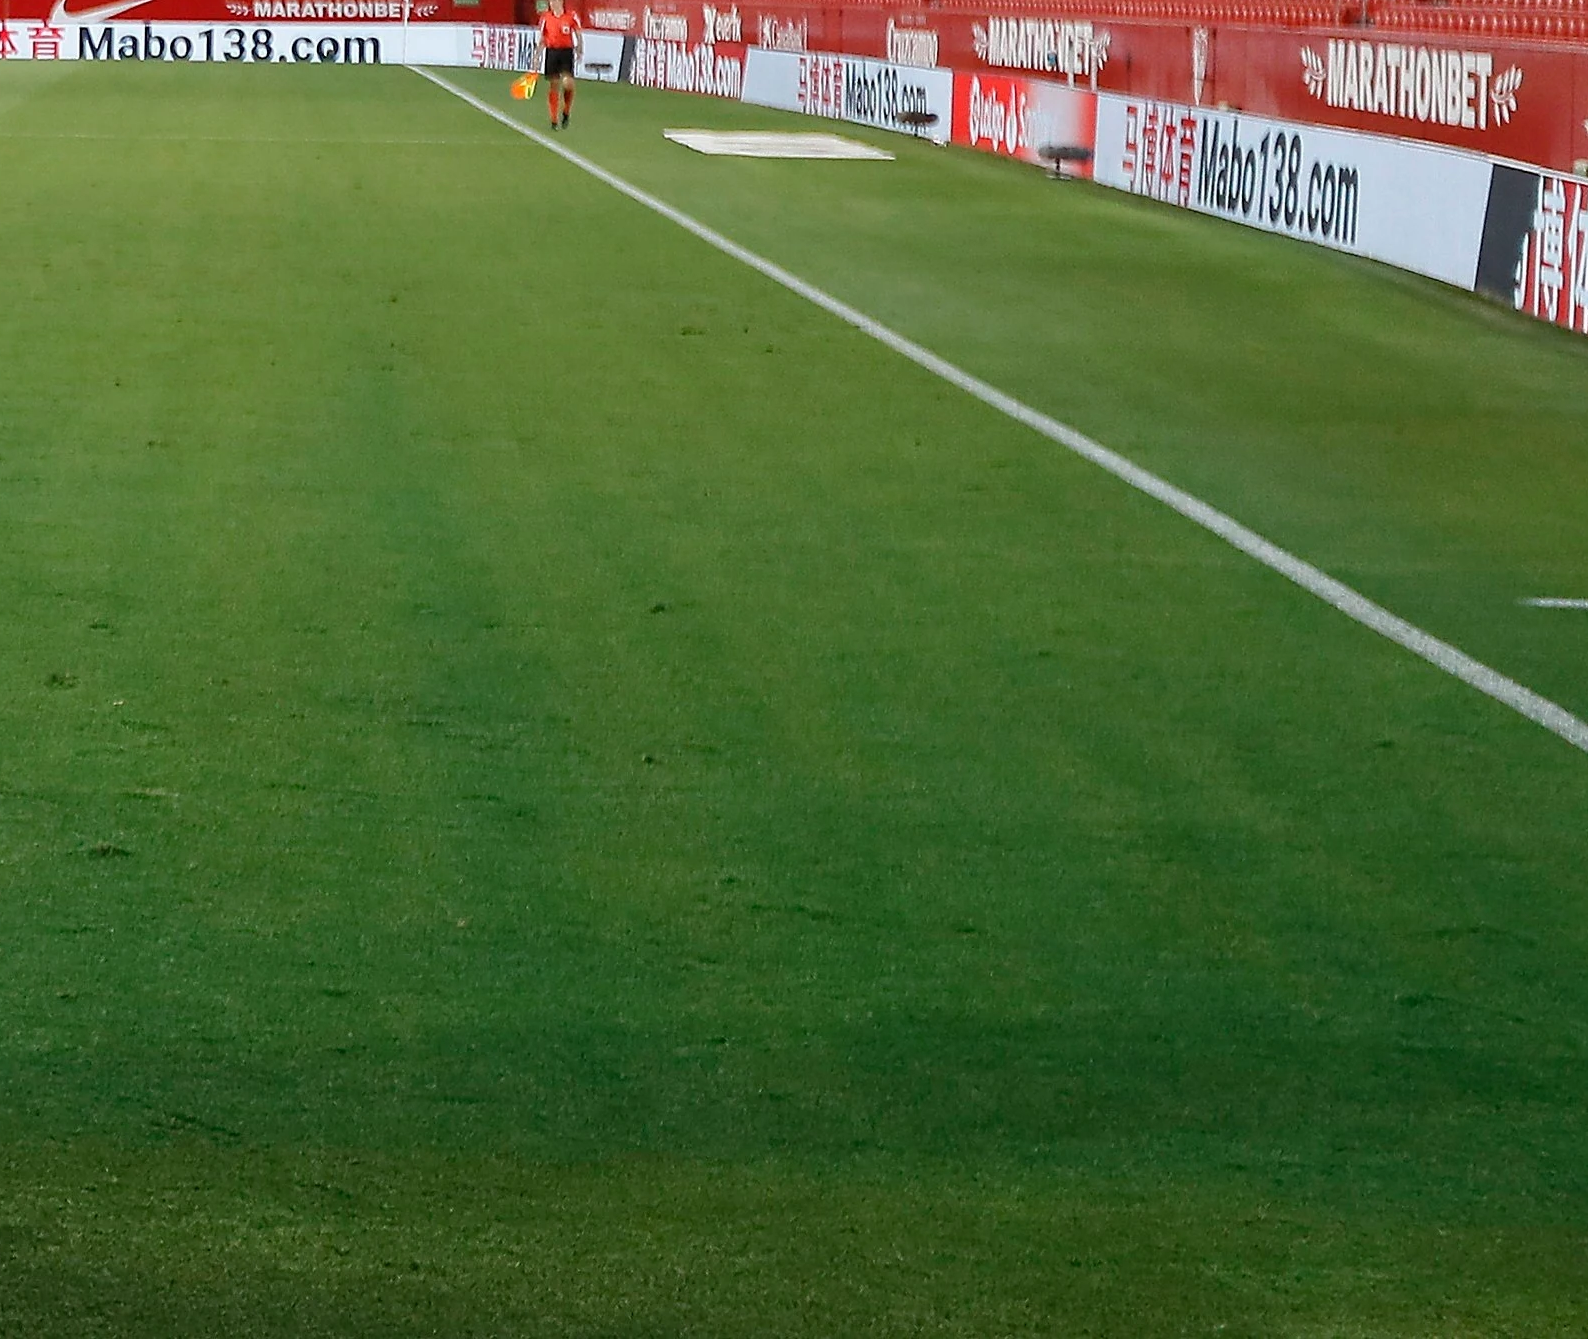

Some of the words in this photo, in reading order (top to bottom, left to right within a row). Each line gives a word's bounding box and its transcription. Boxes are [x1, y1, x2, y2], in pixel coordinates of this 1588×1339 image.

[78, 24, 381, 64] Mabo138.com
[666, 39, 741, 99] Mabo138.com
[1325, 37, 1494, 131] MARATHONBET
[1123, 104, 1197, 209] 马博体育
[1197, 117, 1360, 248] Mabo138.com
